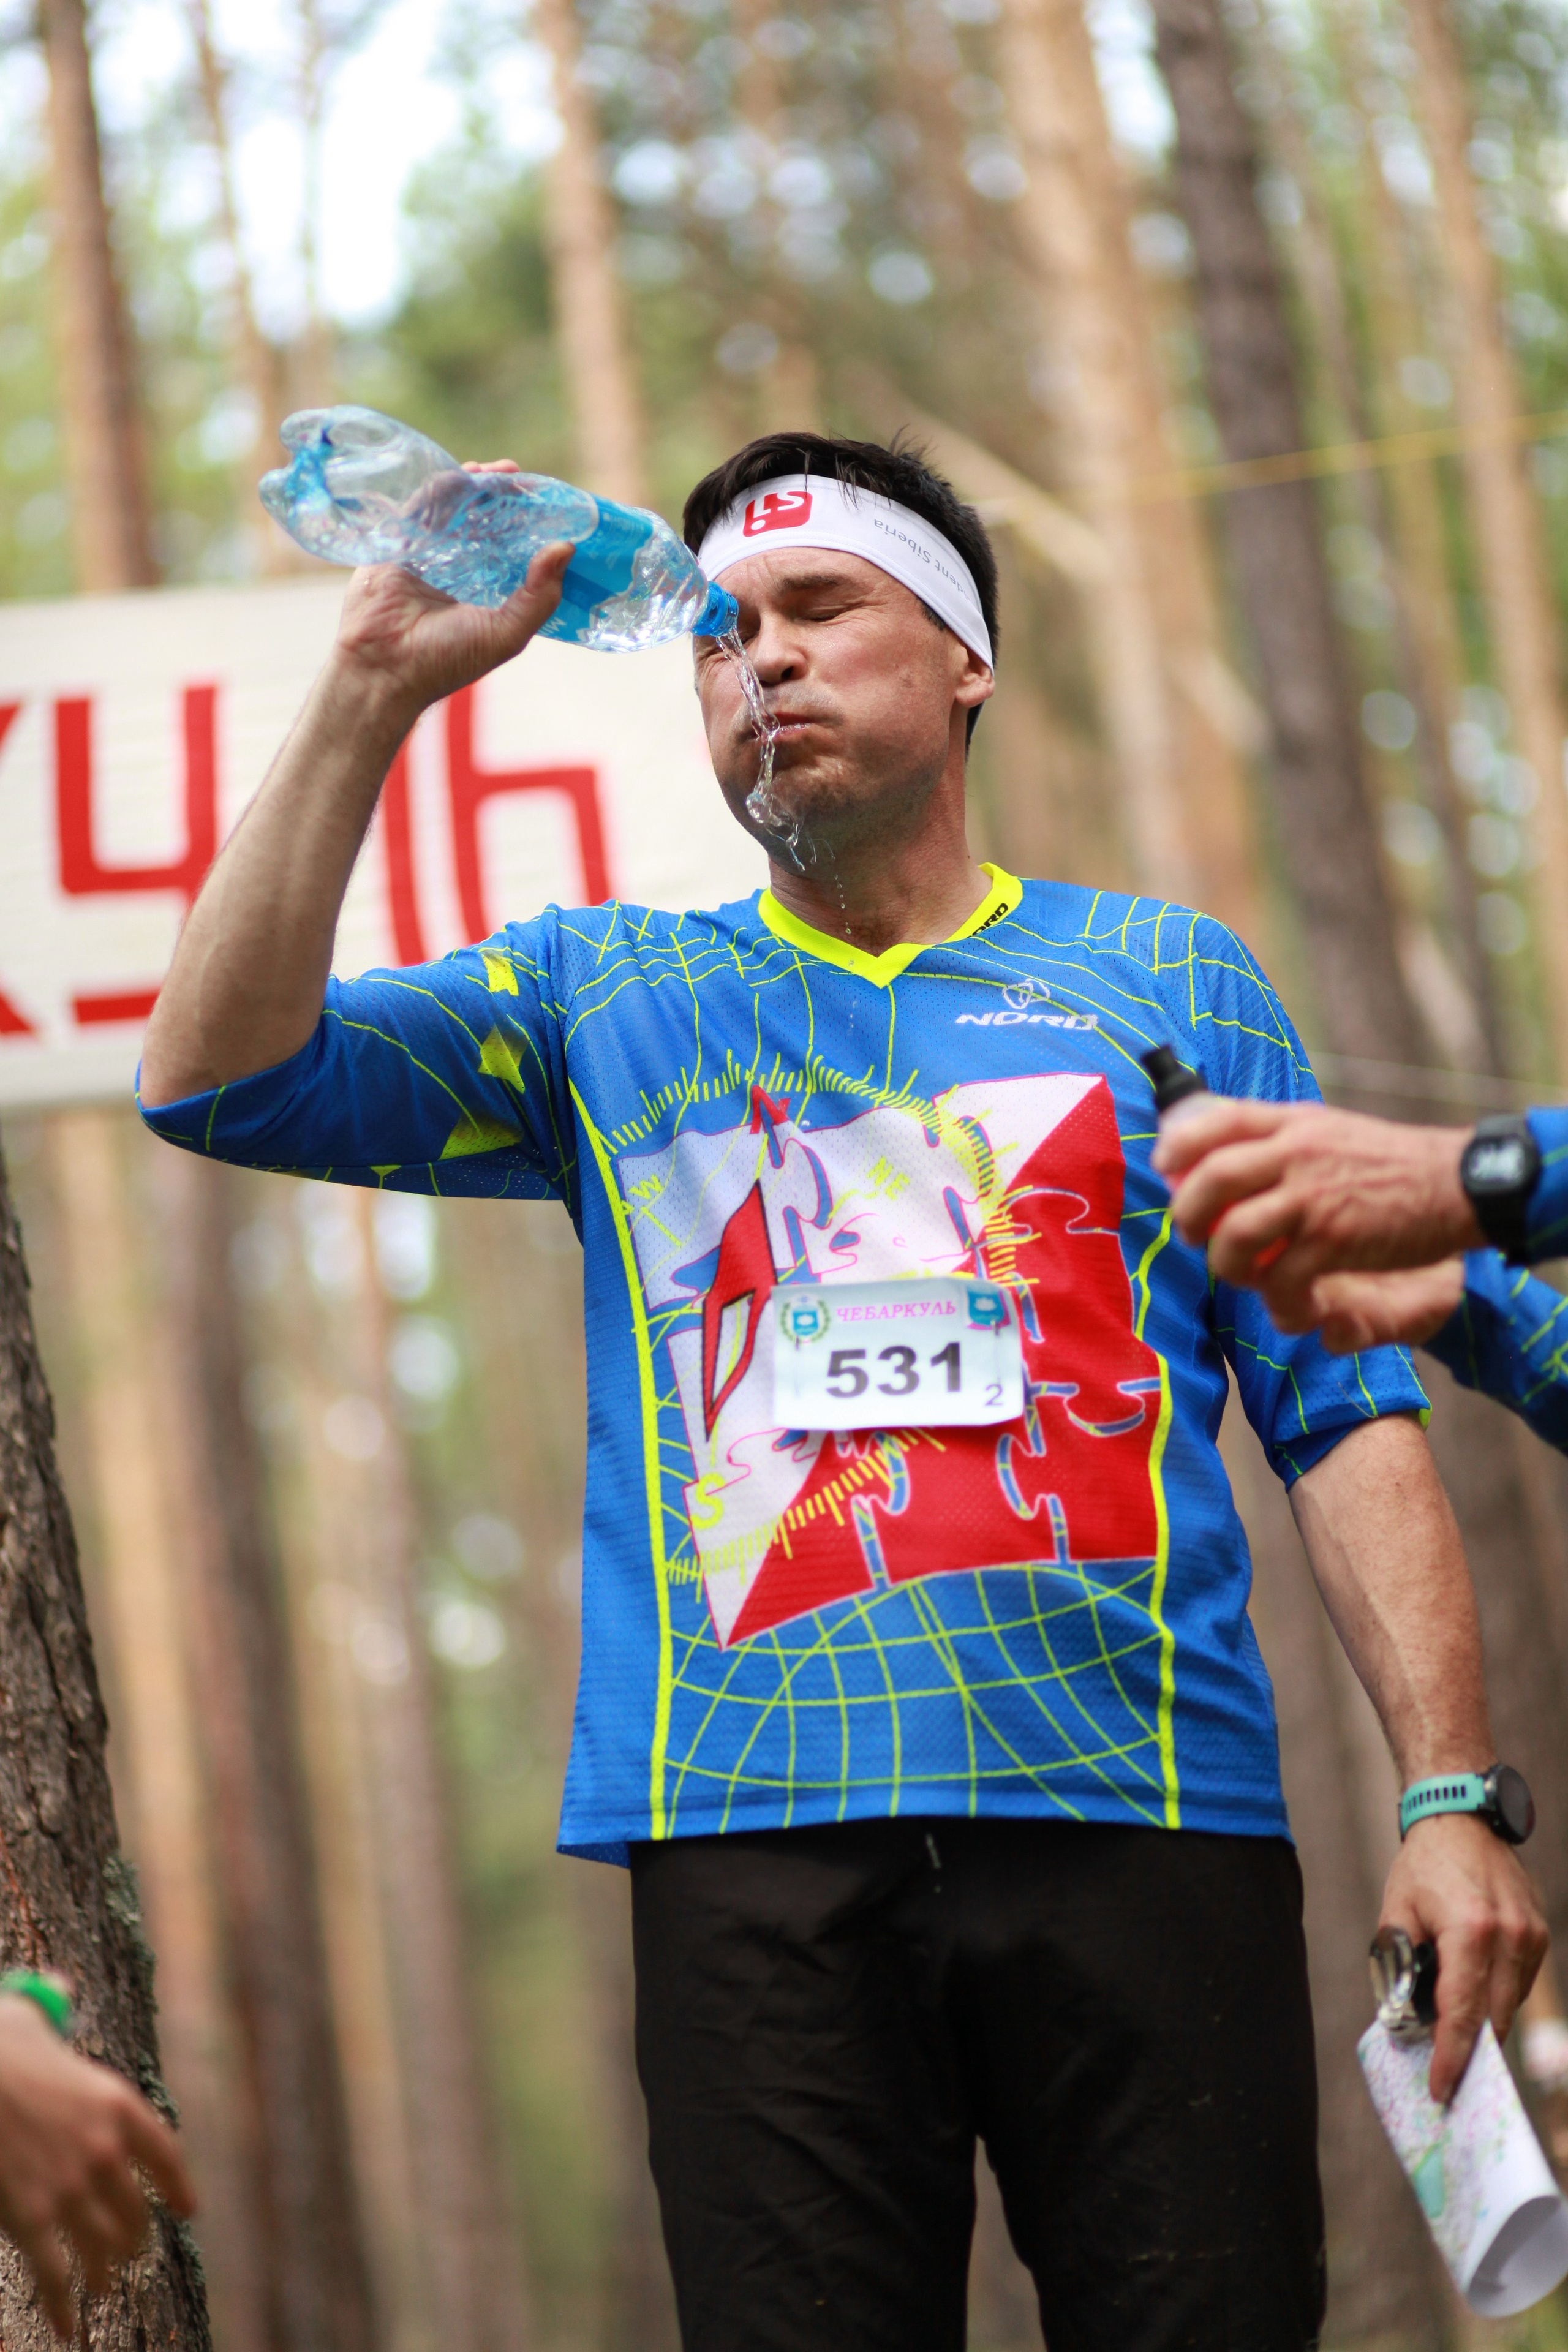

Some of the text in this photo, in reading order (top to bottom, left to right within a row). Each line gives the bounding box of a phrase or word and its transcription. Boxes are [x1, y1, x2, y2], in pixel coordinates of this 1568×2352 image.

[874, 519, 932, 564] Siberia
[967, 903, 1008, 938] ORD
[954, 1011, 1099, 1030] NORD
[866, 1155, 910, 1201] NE
[837, 1301, 957, 1322] ЧЕБАРКУЛЬ
[825, 1341, 961, 1398] 531
[984, 1384, 1004, 1406] 2
[690, 1473, 725, 1529] S
